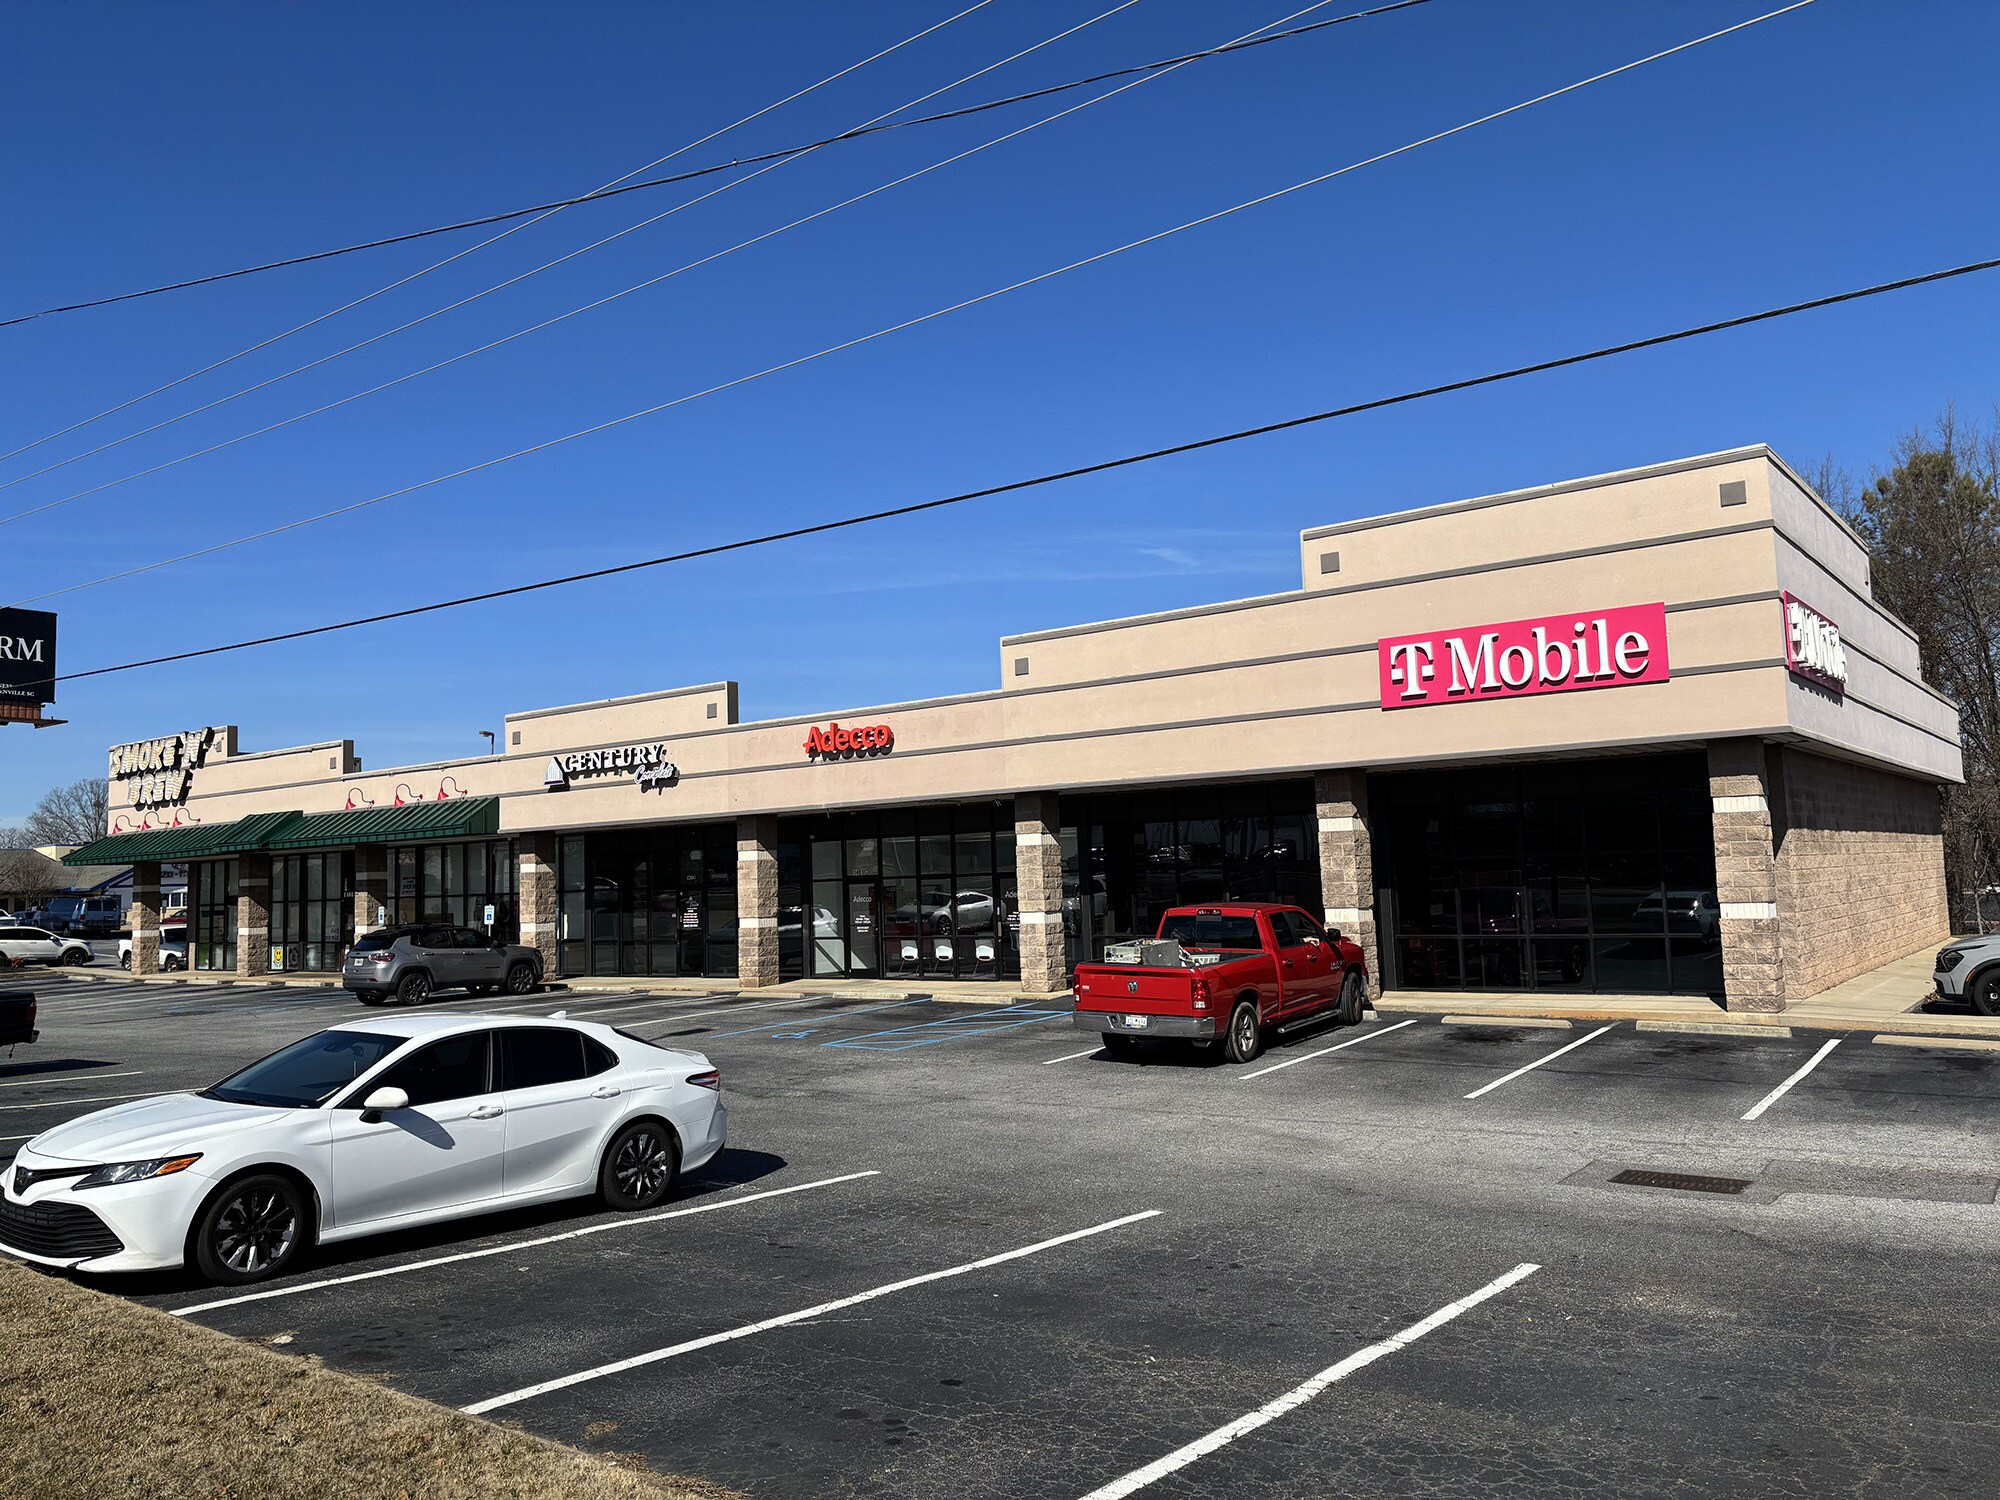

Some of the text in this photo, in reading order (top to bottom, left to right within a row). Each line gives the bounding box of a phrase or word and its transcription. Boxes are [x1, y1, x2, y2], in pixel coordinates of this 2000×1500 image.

[1444, 618, 1650, 695] Mobile
[111, 737, 177, 775] SMOKE
[803, 722, 894, 754] Adecco
[563, 743, 662, 773] CENTURY
[127, 769, 186, 806] BREW
